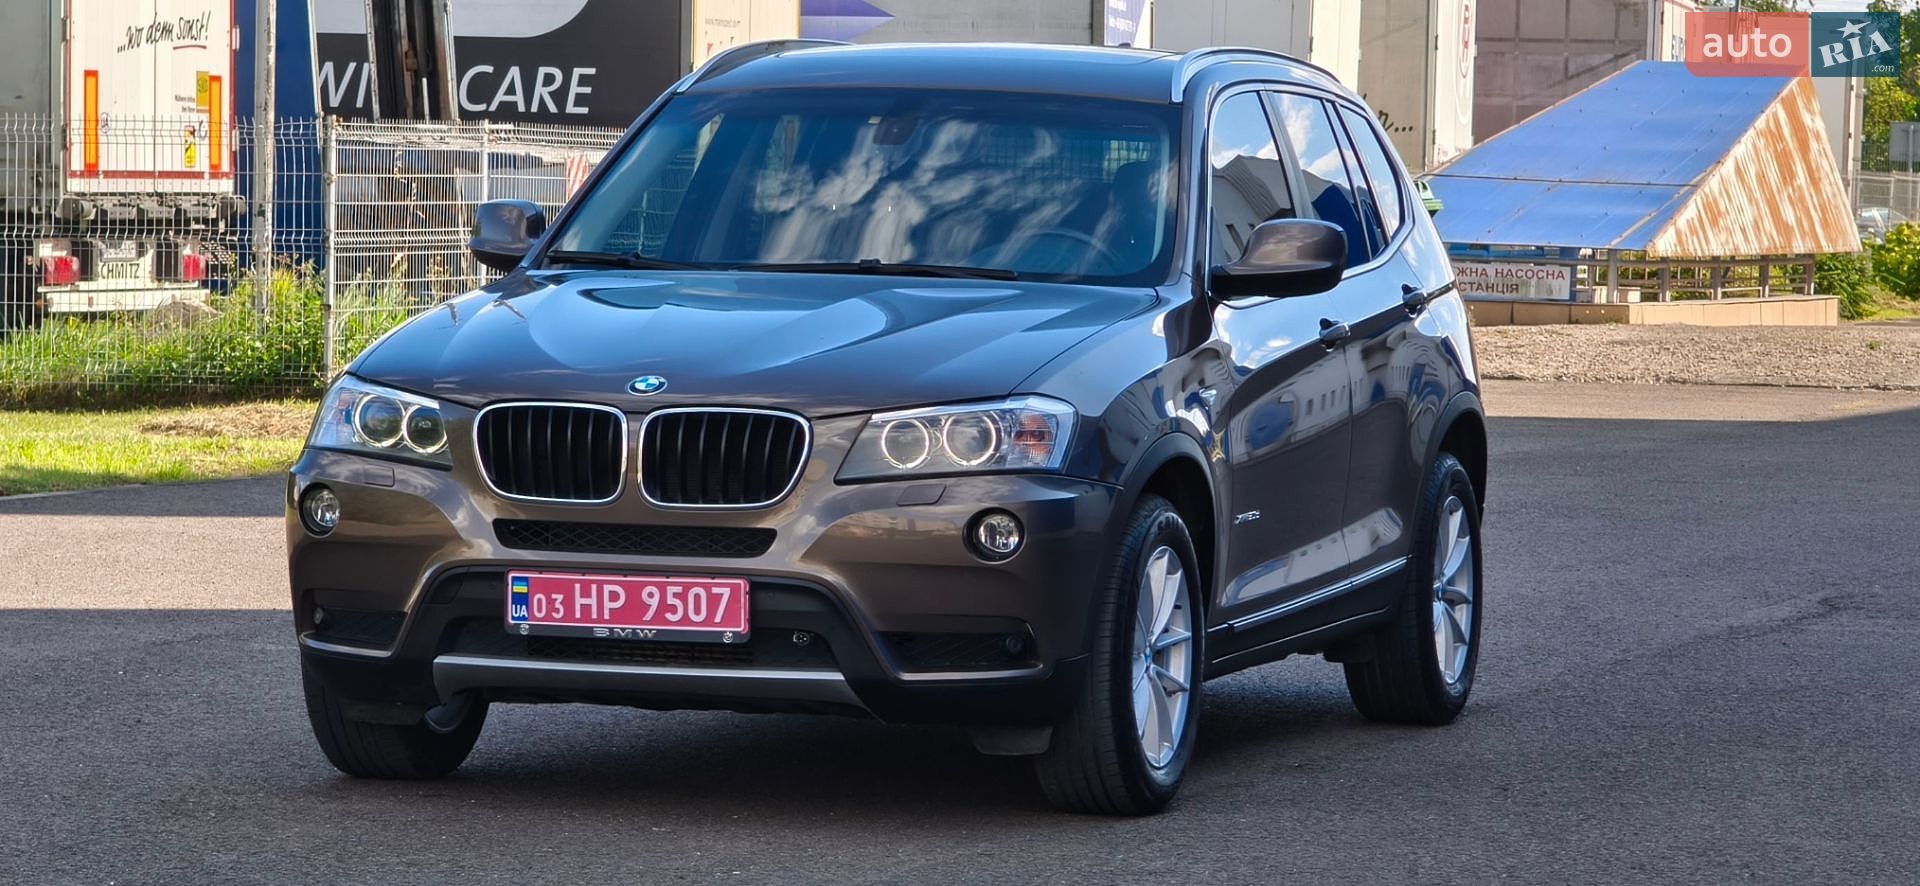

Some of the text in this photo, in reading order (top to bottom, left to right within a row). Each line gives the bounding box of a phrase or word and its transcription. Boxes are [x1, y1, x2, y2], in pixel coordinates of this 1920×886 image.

[176, 10, 212, 42] sonst!
[458, 65, 597, 114] CARE
[1495, 268, 1566, 280] НАСОСНА
[1459, 281, 1519, 295] СТАНЦІЯ
[533, 583, 731, 624] 03 HP 9507
[511, 604, 528, 618] UA
[592, 627, 657, 639] BMW
